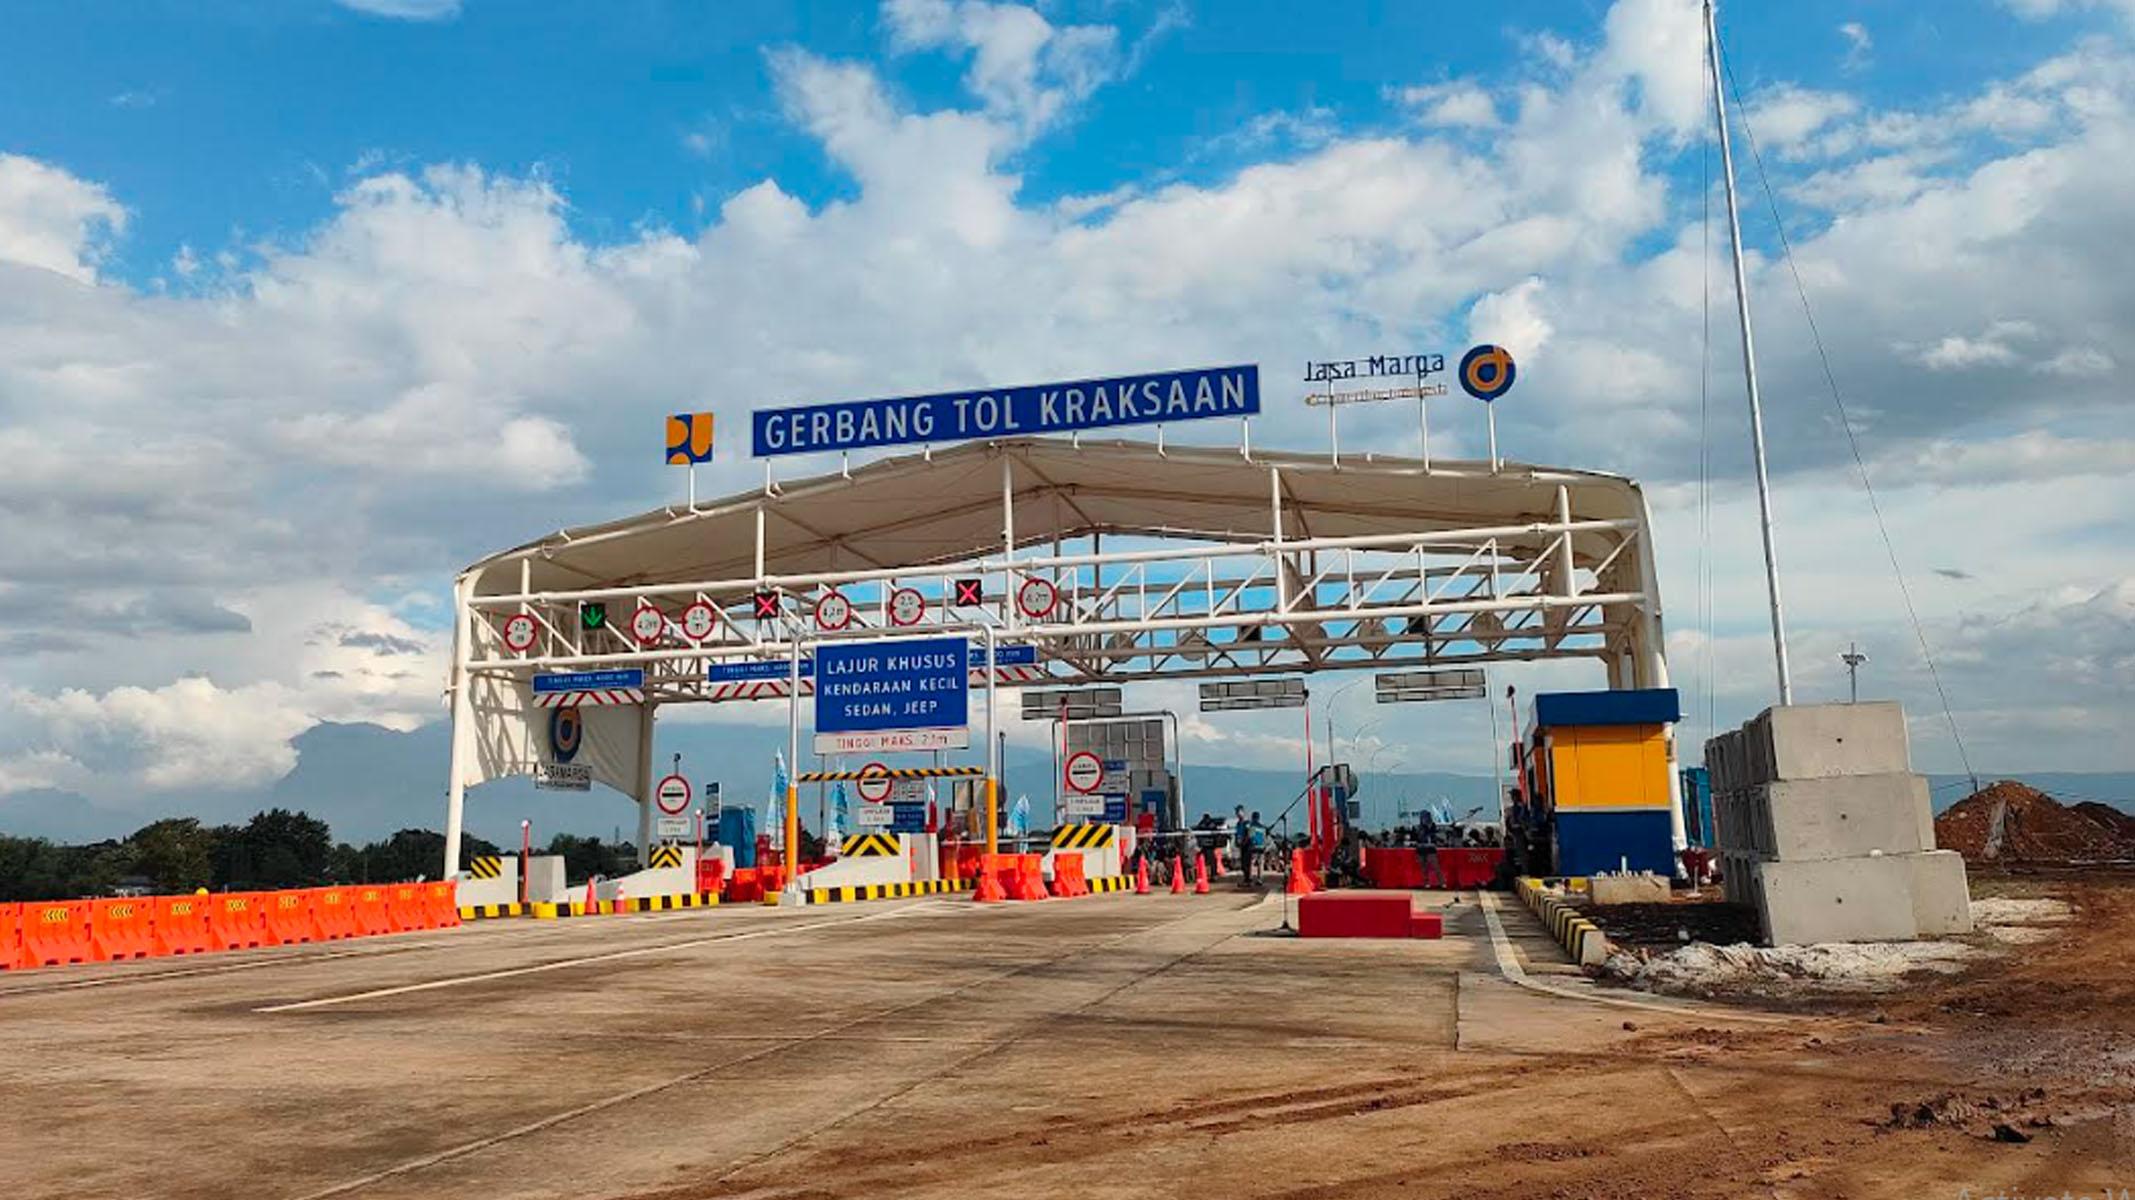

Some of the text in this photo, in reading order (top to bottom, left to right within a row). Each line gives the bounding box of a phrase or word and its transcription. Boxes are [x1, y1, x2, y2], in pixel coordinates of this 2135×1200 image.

[1304, 354, 1444, 382] Jasa Marga
[765, 374, 1245, 449] GERBANG TOL KRAKSAAN
[827, 657, 878, 675] LAJUR
[887, 654, 956, 671] KHUSUS
[824, 677, 959, 696] KENDARAAN KECIL
[844, 700, 937, 718] SEDAN, JEEP
